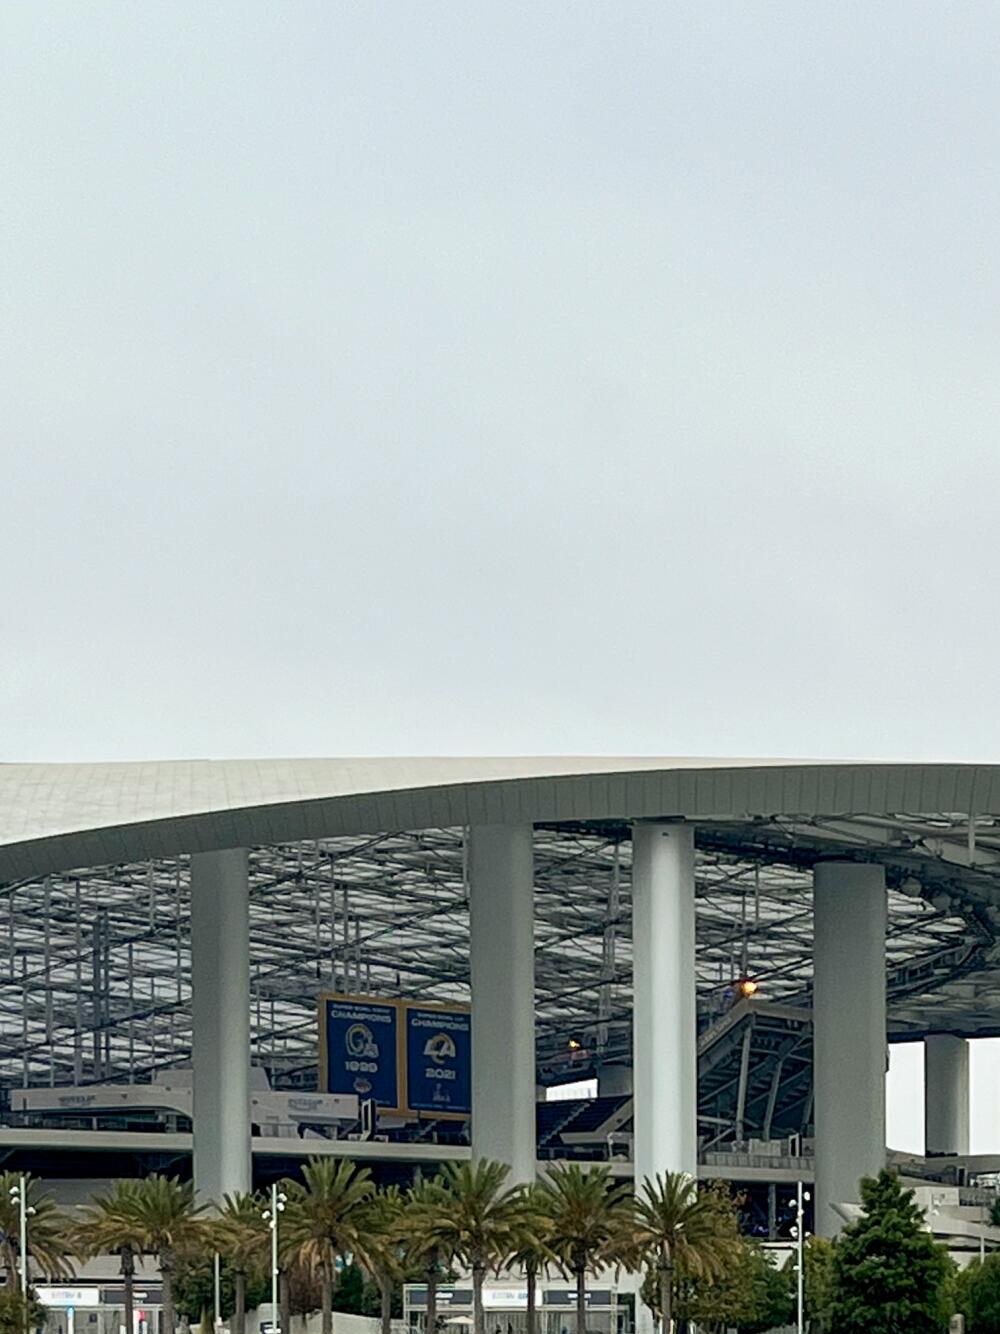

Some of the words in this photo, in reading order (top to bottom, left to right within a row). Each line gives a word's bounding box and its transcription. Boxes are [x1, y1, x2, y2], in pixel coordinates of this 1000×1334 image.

[331, 1010, 392, 1024] CHAMPIONS
[411, 1018, 469, 1032] CHAMPIONS
[425, 1067, 456, 1080] 2021
